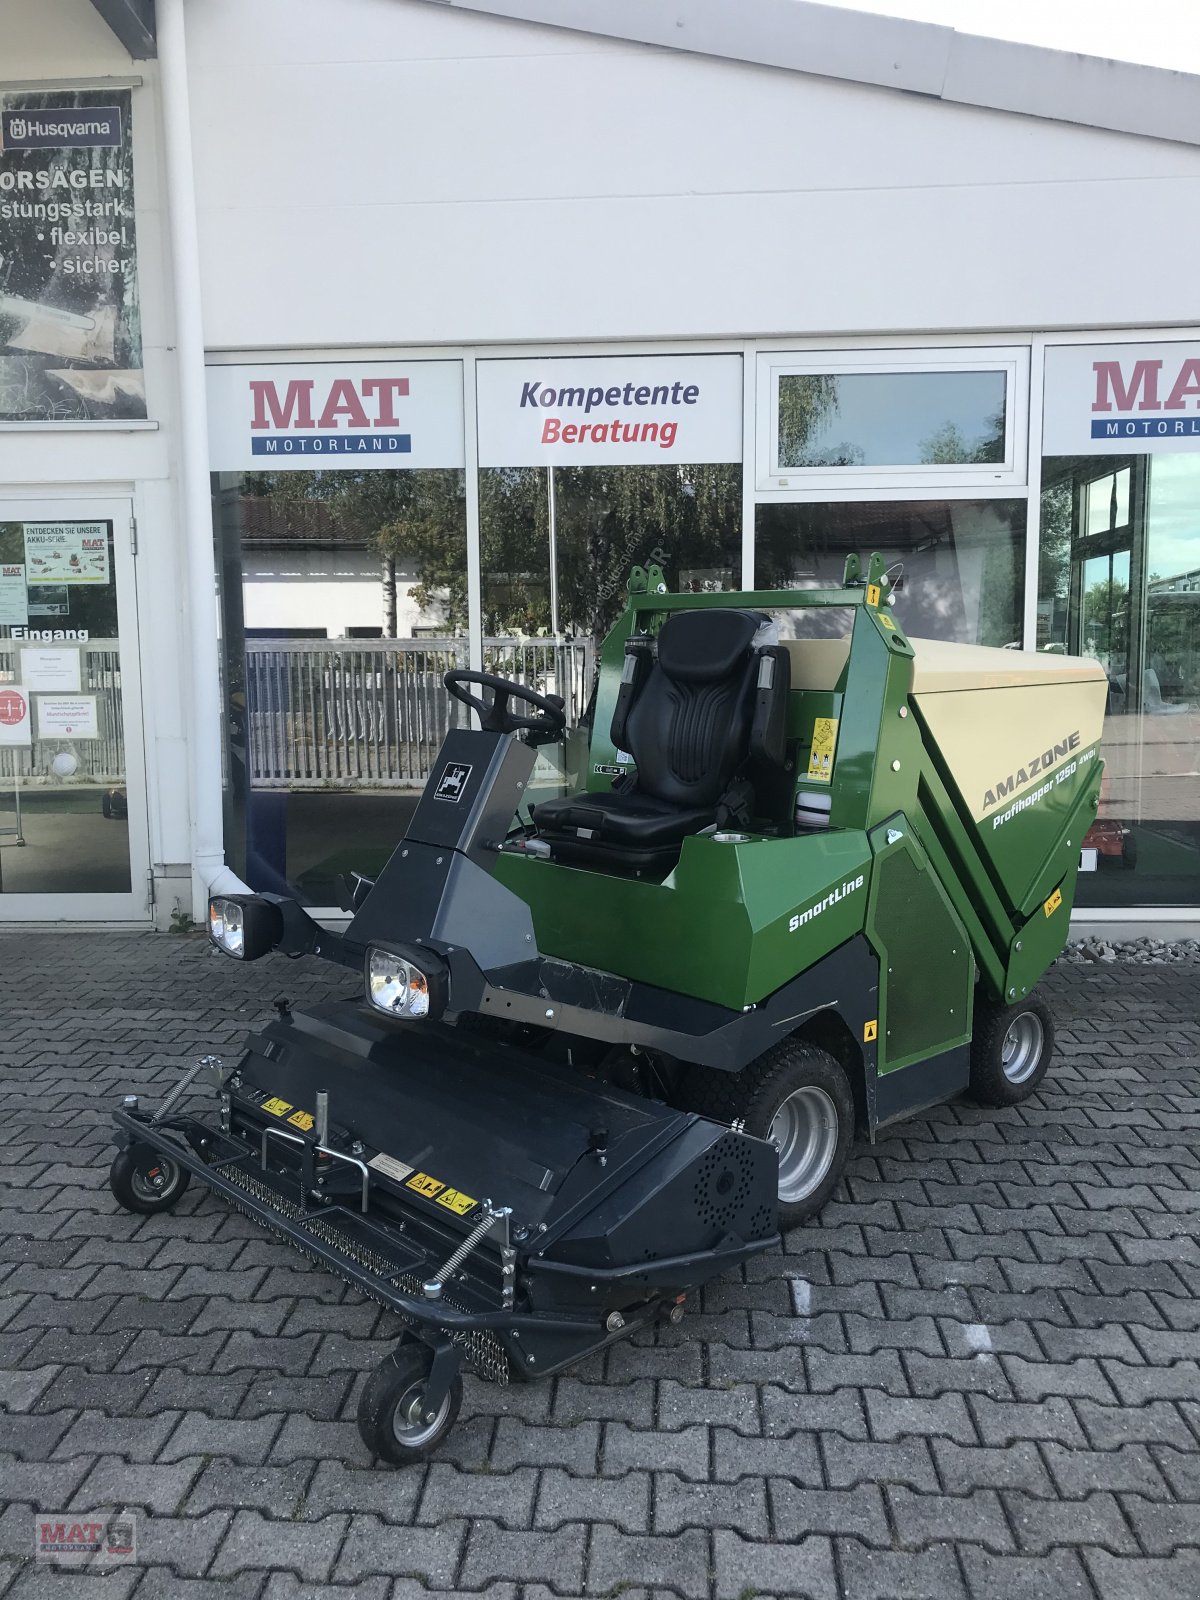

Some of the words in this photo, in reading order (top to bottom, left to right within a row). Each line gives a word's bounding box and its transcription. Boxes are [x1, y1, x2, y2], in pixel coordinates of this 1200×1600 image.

[27, 121, 110, 137] Husqvarna
[50, 227, 126, 245] flexibel
[63, 256, 129, 274] sicher
[249, 377, 410, 430] MAT
[519, 381, 700, 414] Kompetente
[266, 438, 398, 452] MOTORLAND
[541, 418, 678, 449] Beratung
[77, 526, 101, 534] UNSERE
[10, 627, 89, 643] Eingang
[982, 730, 1081, 811] AMAZONE
[993, 780, 1054, 830] Profihopper
[1055, 761, 1077, 785] 1250
[788, 874, 864, 933] SmartLine
